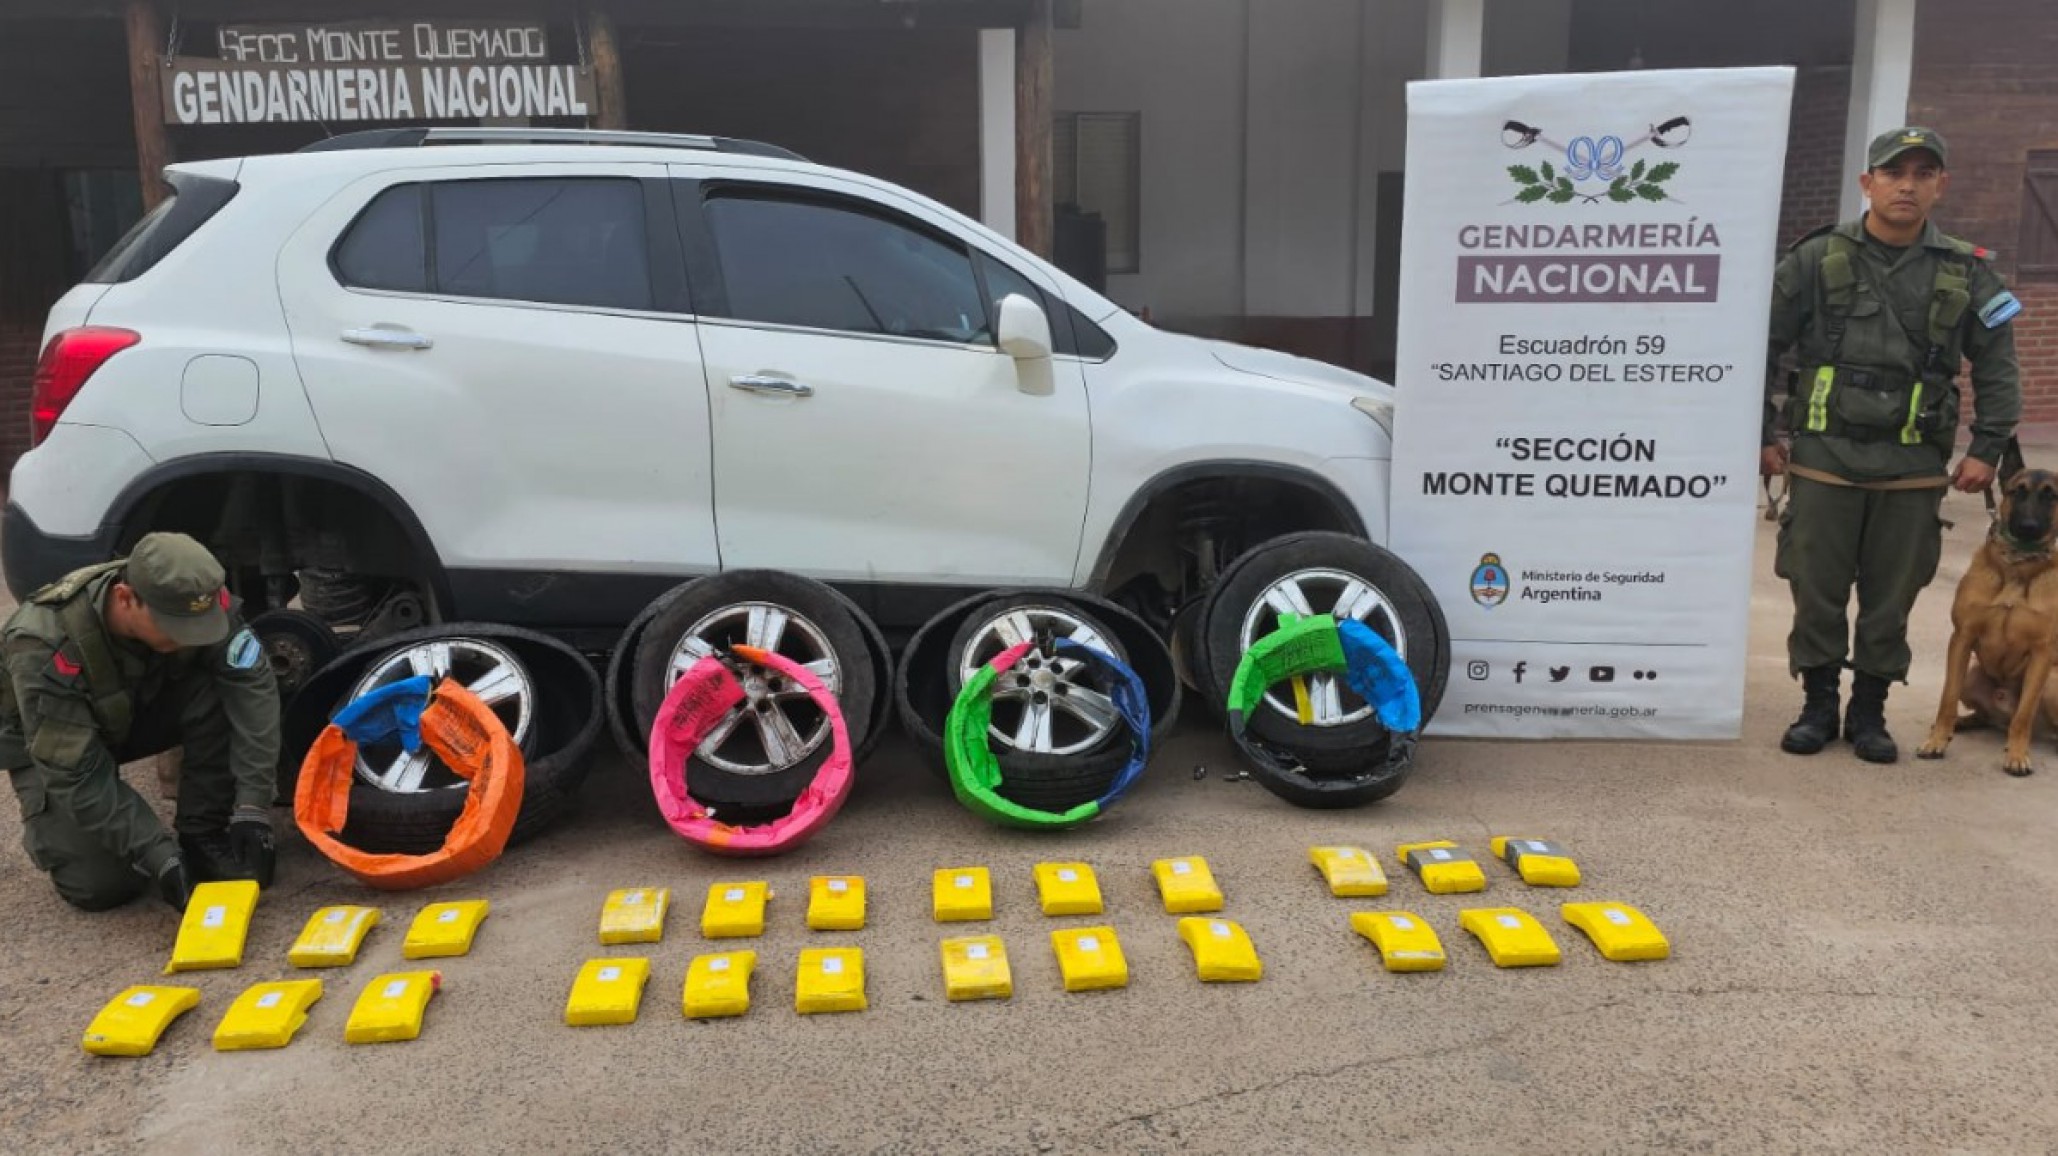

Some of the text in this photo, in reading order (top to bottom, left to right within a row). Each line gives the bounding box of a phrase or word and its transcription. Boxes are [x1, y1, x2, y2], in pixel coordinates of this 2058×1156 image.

[306, 28, 402, 62] MONTE
[173, 65, 588, 124] GENDARMERIA NACIONAL
[1458, 216, 1721, 249] GENDARMERÍA
[1474, 263, 1706, 294] NACIONAL
[1499, 334, 1666, 355] Escuadrón 59
[1431, 363, 1733, 383] “SANTIAGO DEL ESTERO”
[1495, 433, 1656, 462] “SECCIÓN
[1422, 472, 1728, 499] MONTE QUEMADO”
[1521, 570, 1665, 585] Ministerio de Seguridad
[1521, 586, 1602, 604] Argentina
